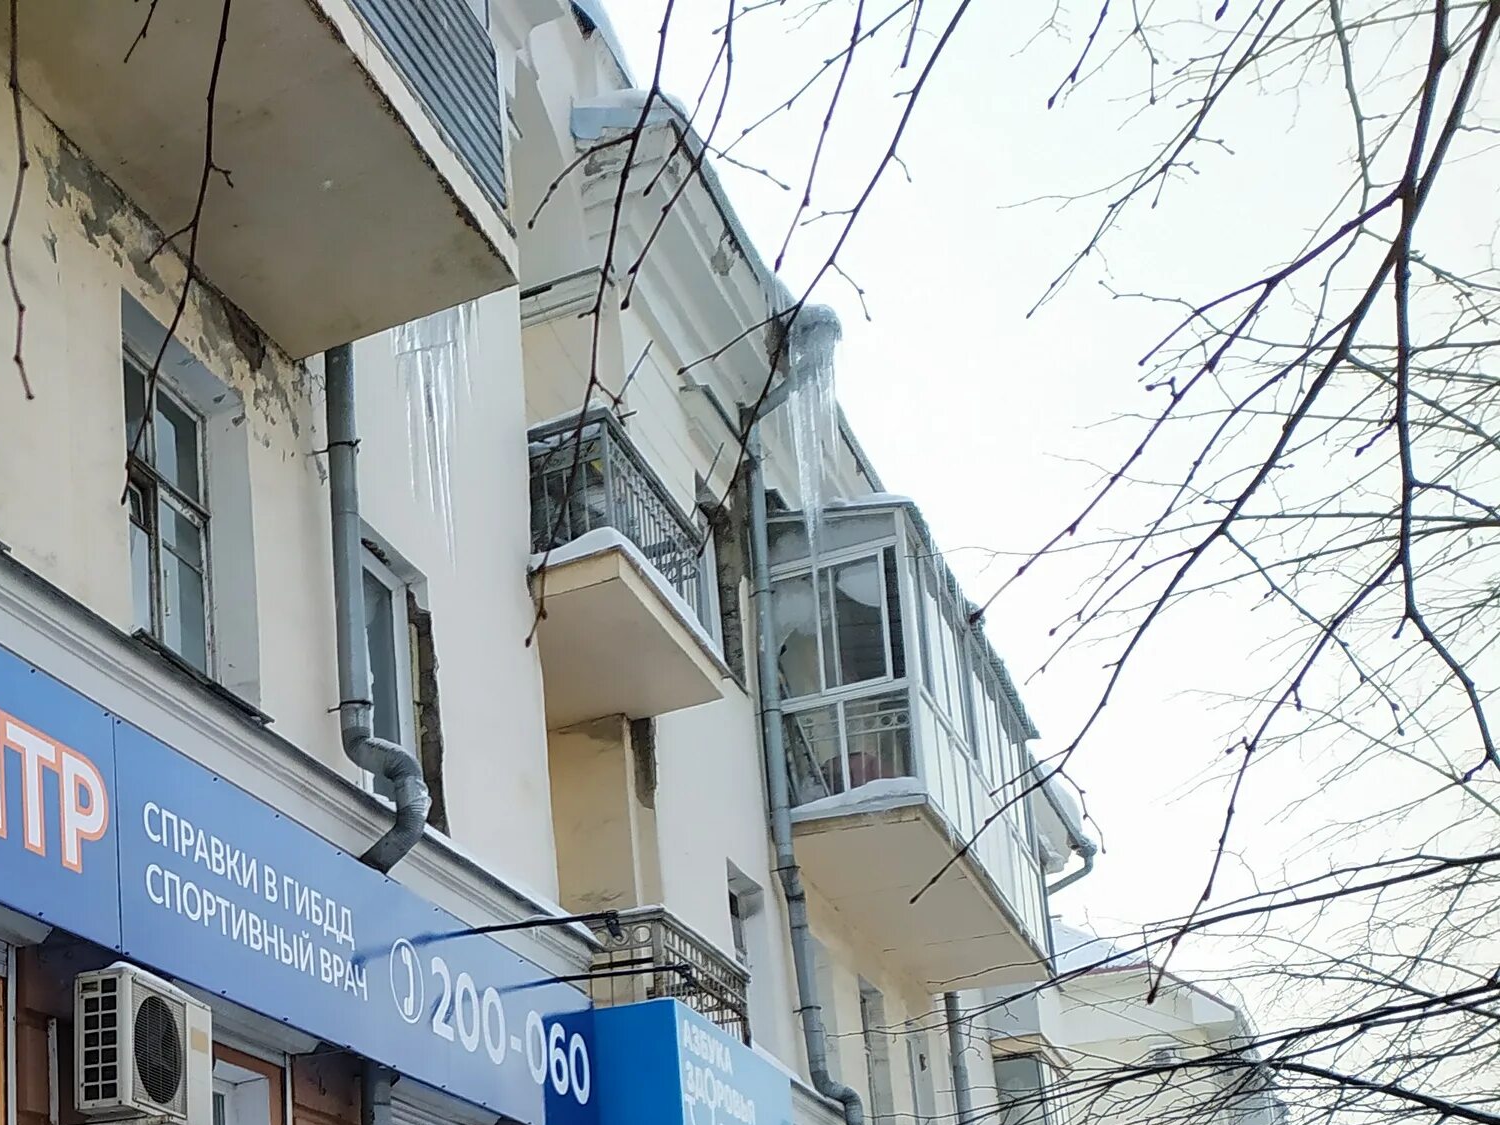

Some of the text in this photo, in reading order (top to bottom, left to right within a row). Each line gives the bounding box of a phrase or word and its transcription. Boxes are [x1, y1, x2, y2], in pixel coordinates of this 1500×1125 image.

[143, 801, 356, 952] СПРАВКИ В ГИБДД
[145, 863, 369, 1002] СПОРТИВНЫЙ ВРАЧ
[430, 956, 591, 1105] 200-060
[683, 1019, 734, 1076] АЗБУКА
